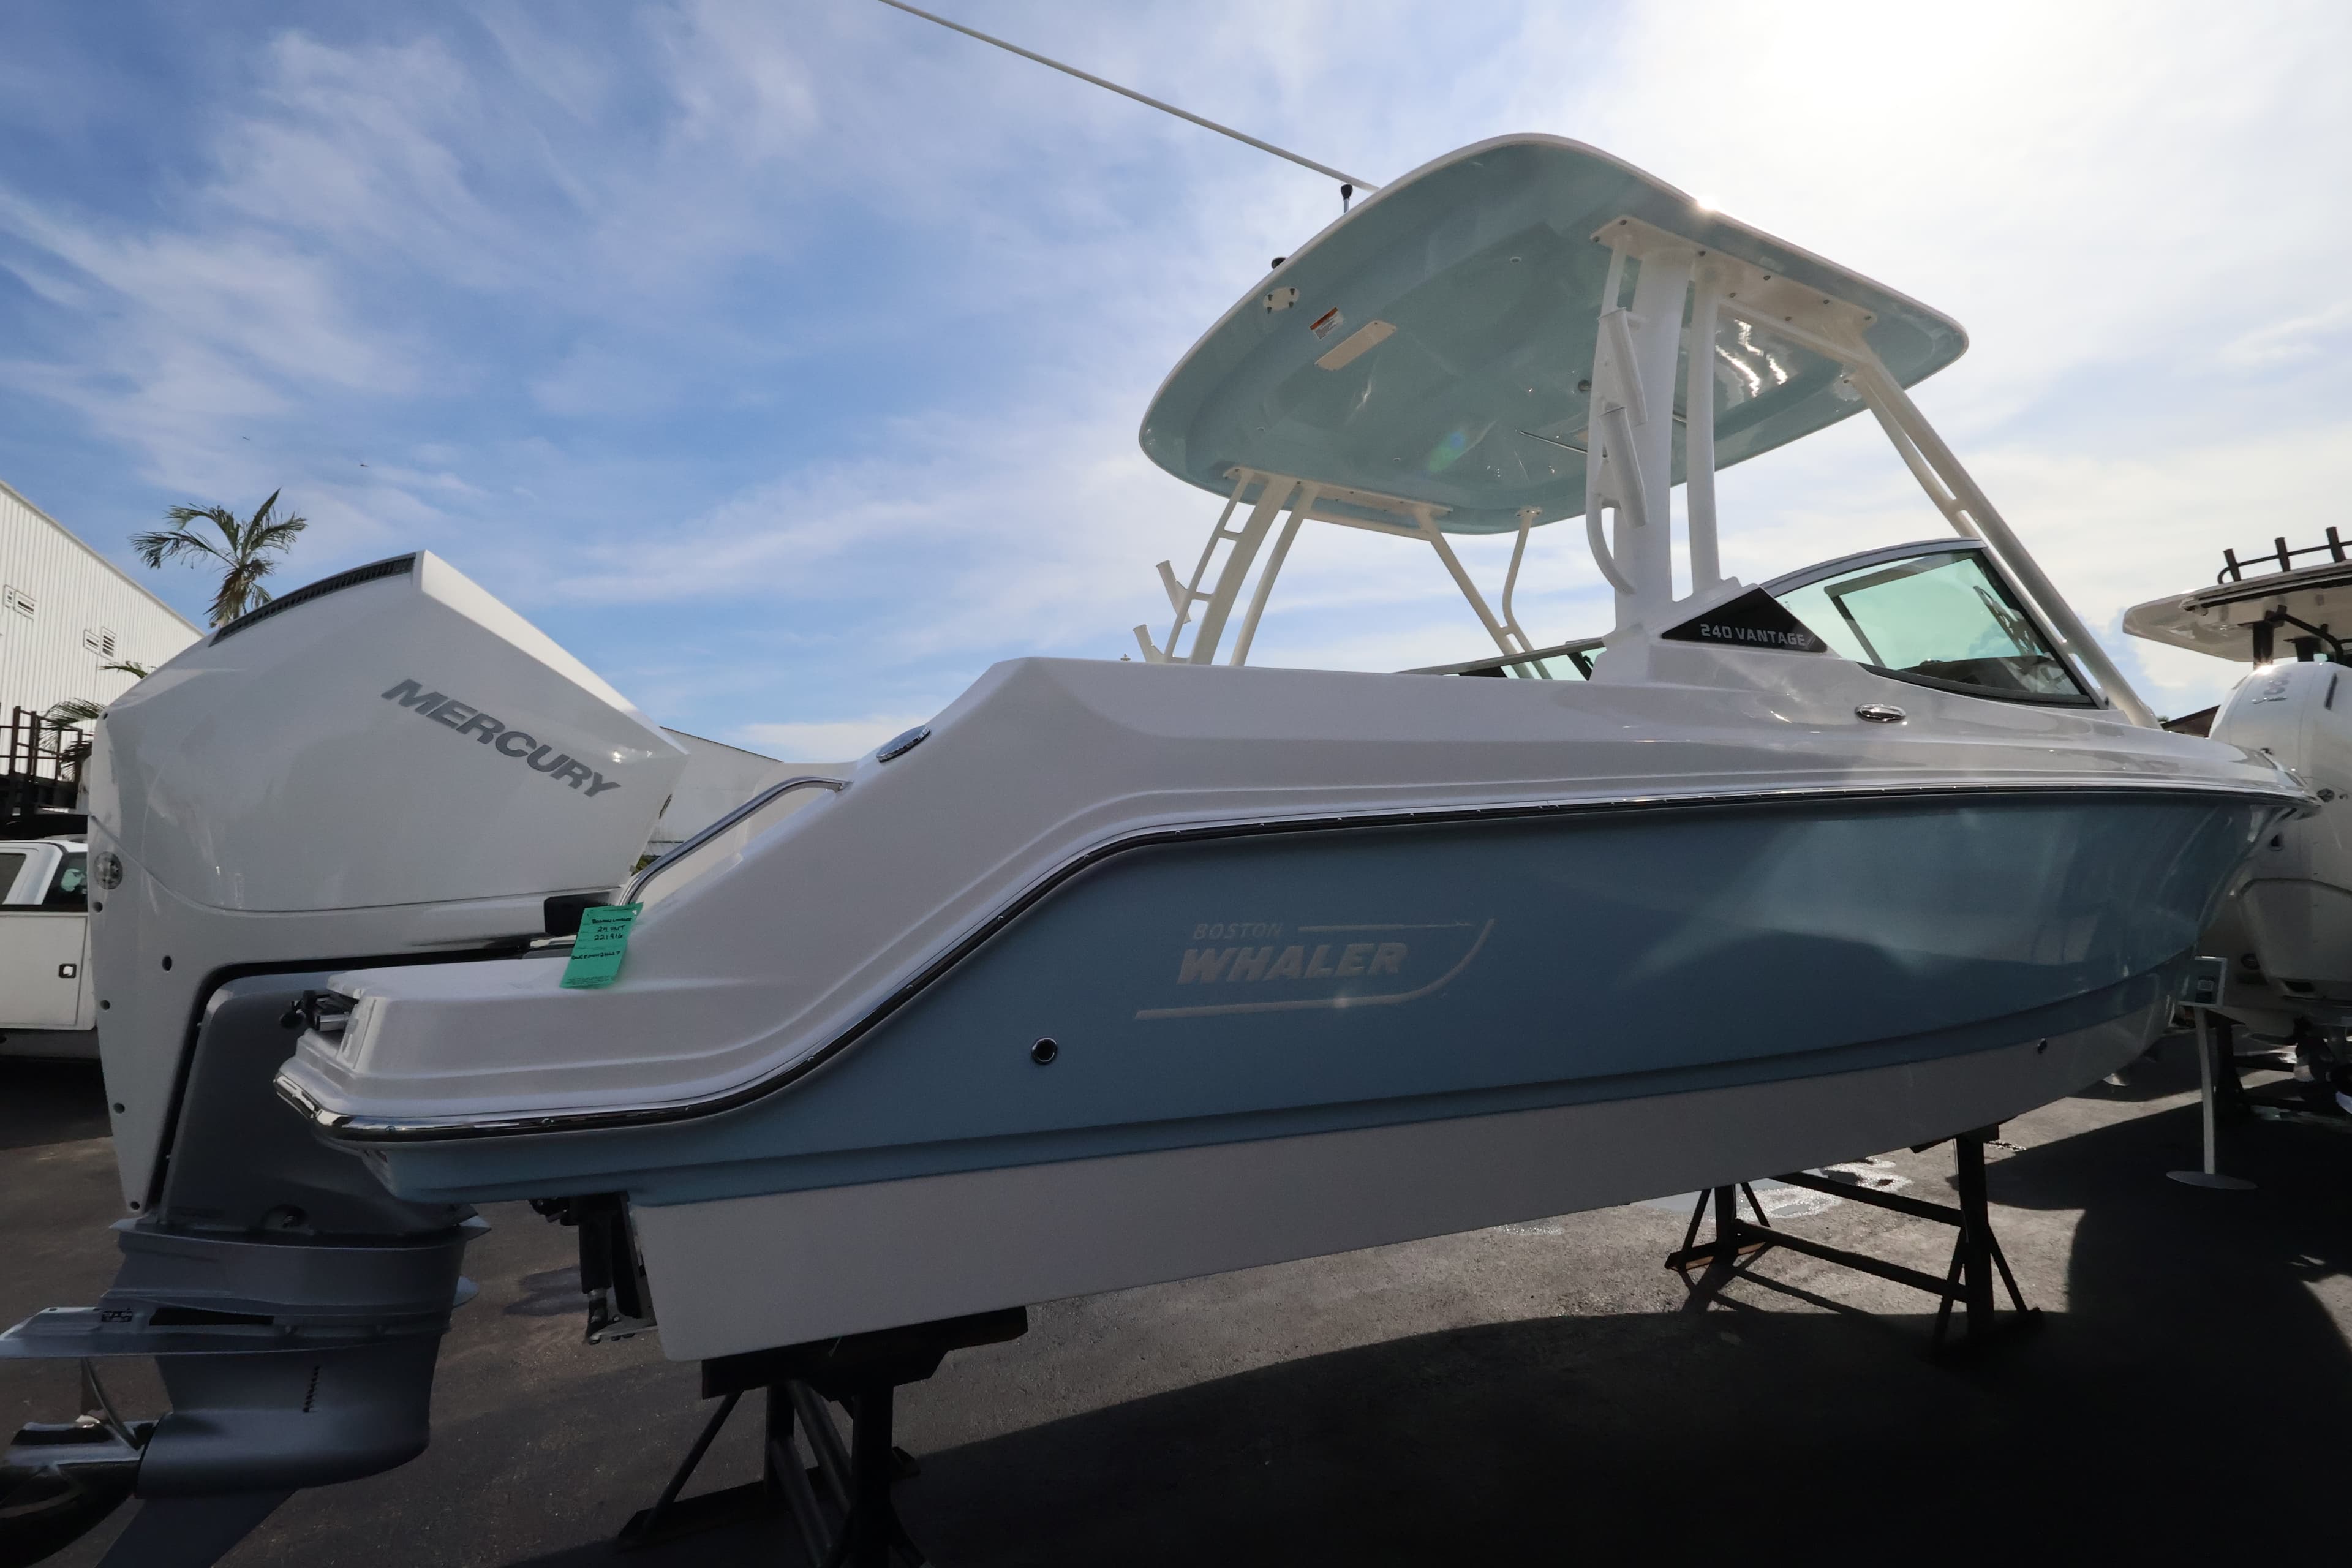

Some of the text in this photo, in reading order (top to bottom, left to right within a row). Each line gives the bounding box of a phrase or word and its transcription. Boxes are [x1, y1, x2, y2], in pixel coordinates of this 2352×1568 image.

[1700, 624, 1806, 646] 240 VANTAGE
[381, 679, 621, 797] MERCURY
[1193, 923, 1283, 940] BOSTON
[1176, 943, 1409, 984] WHALER
